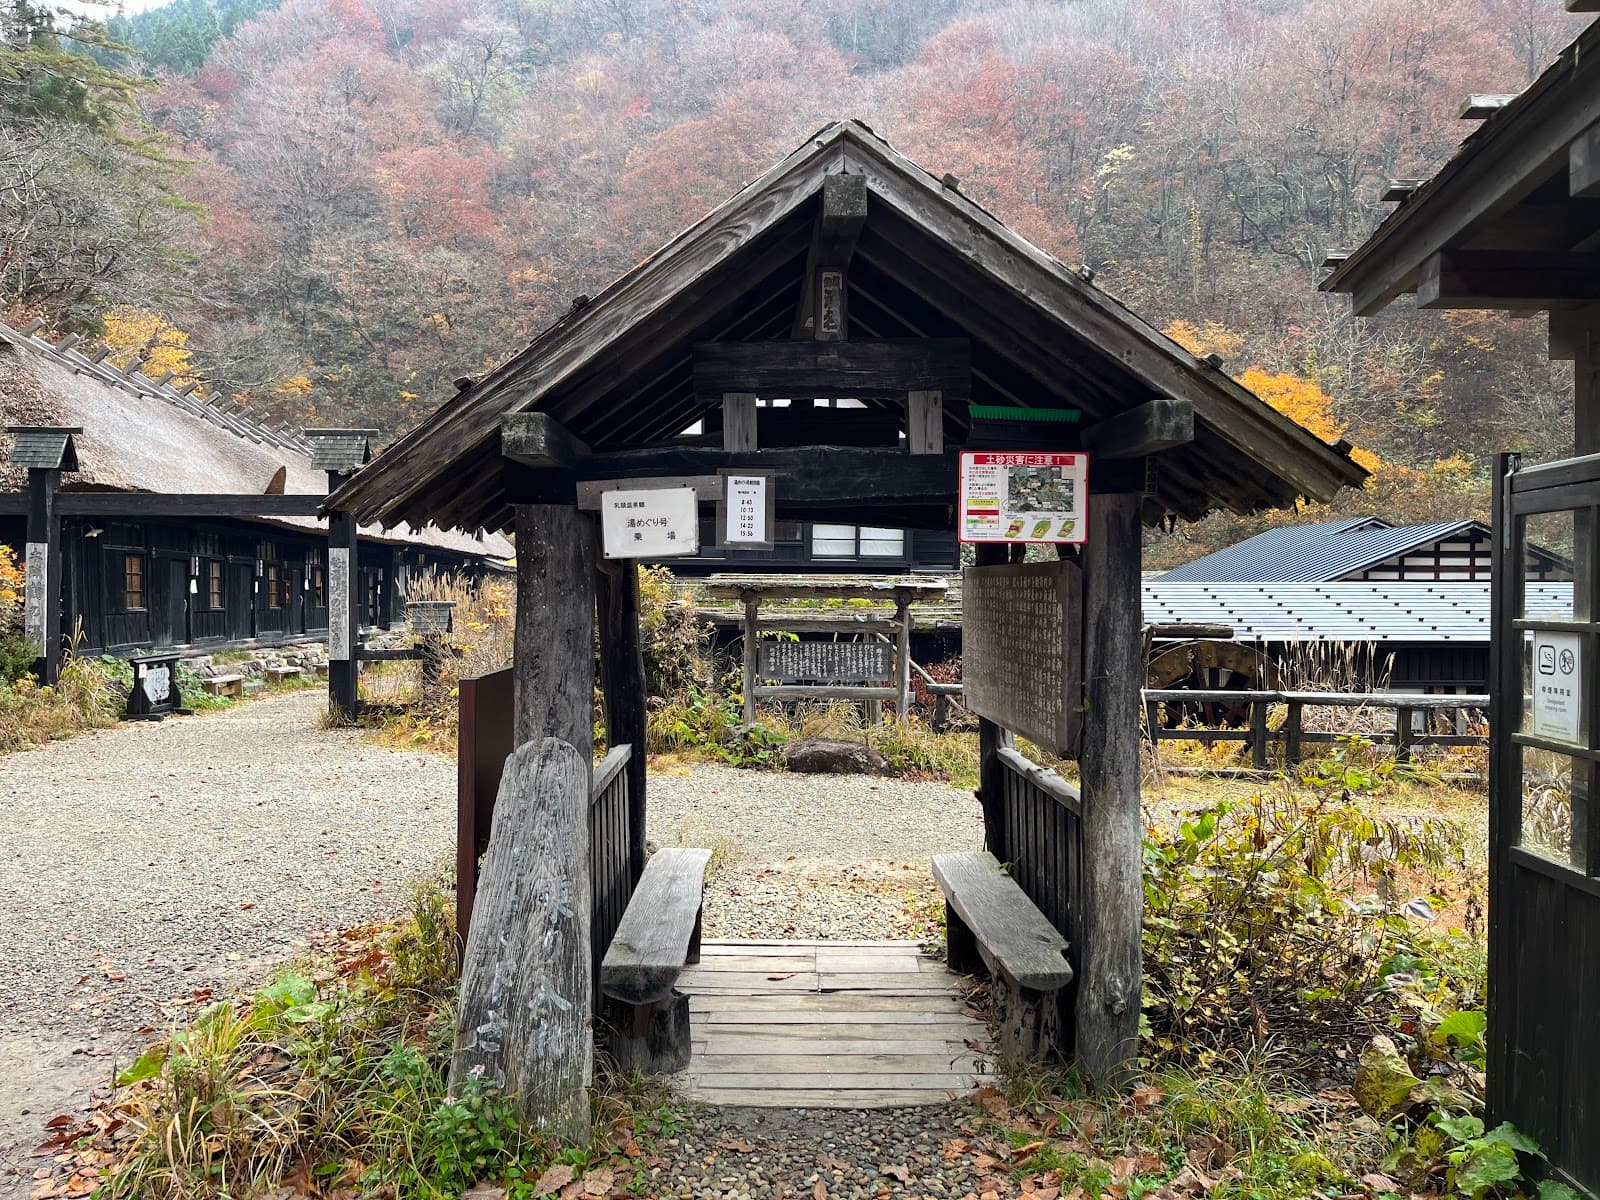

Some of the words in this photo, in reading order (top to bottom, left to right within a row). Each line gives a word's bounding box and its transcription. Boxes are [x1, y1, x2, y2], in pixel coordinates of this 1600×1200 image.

[985, 455, 1060, 465] 土砂災害に注意！
[627, 517, 668, 528] 湯めぐり号
[667, 531, 676, 540] 場
